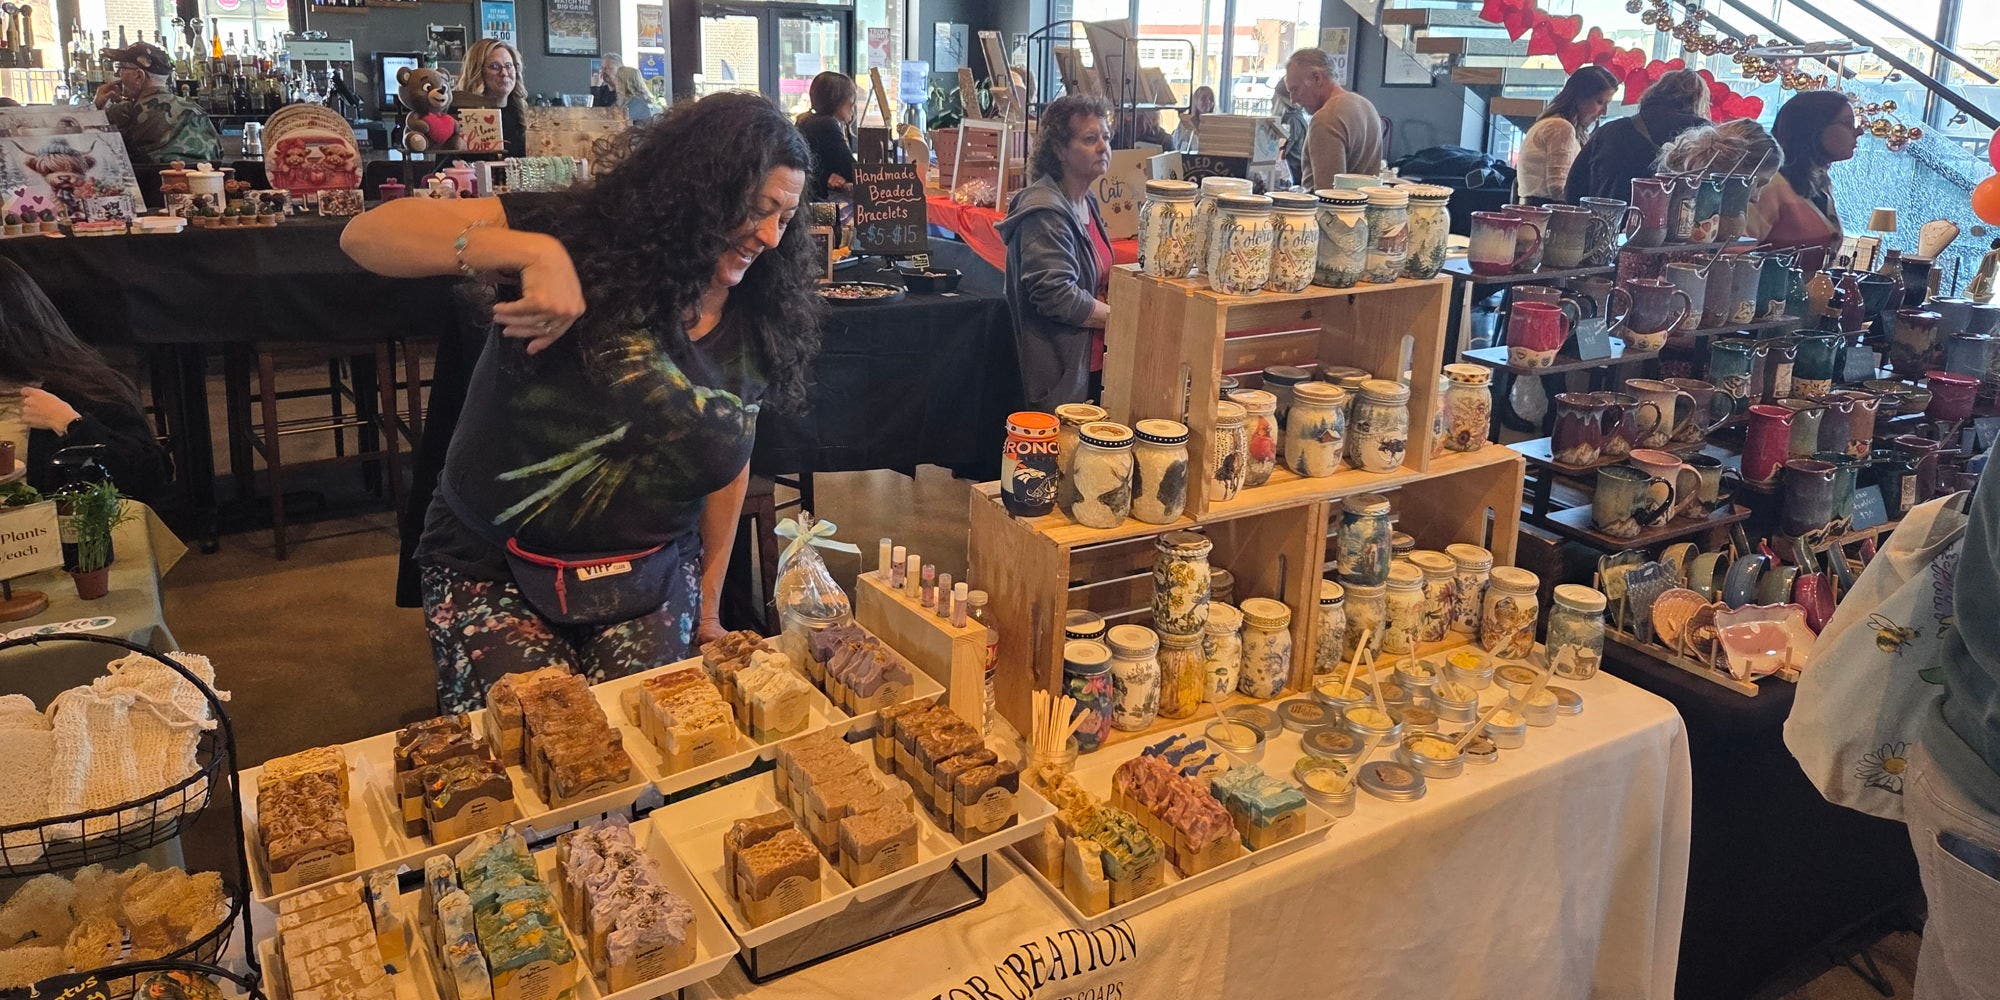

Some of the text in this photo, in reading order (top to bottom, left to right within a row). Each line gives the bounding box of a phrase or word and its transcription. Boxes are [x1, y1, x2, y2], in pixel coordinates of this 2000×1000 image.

[854, 167, 917, 185] Handmade
[869, 184, 914, 201] Beaded
[1099, 178, 1125, 203] Cat
[856, 204, 909, 225] Bracelets
[1, 528, 47, 544] Plants
[994, 918, 1138, 1000] CREATION
